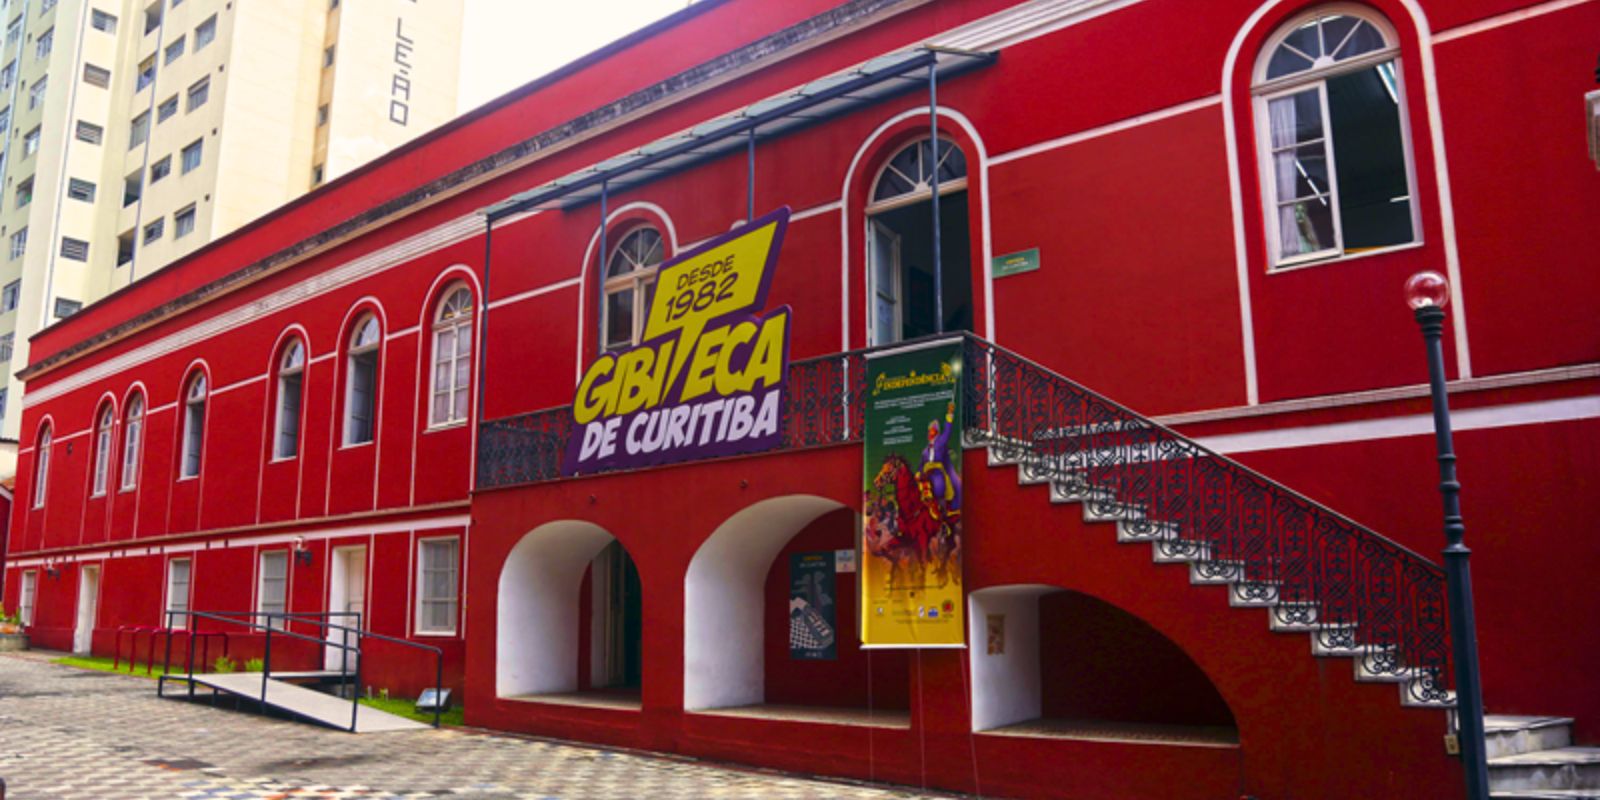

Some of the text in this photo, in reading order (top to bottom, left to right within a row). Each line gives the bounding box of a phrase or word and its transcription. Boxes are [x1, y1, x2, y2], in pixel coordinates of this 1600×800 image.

[665, 272, 739, 322] 1982
[676, 254, 735, 290] DESDE
[573, 312, 788, 425] GIBITECA
[578, 389, 780, 462] DE CURITIBA
